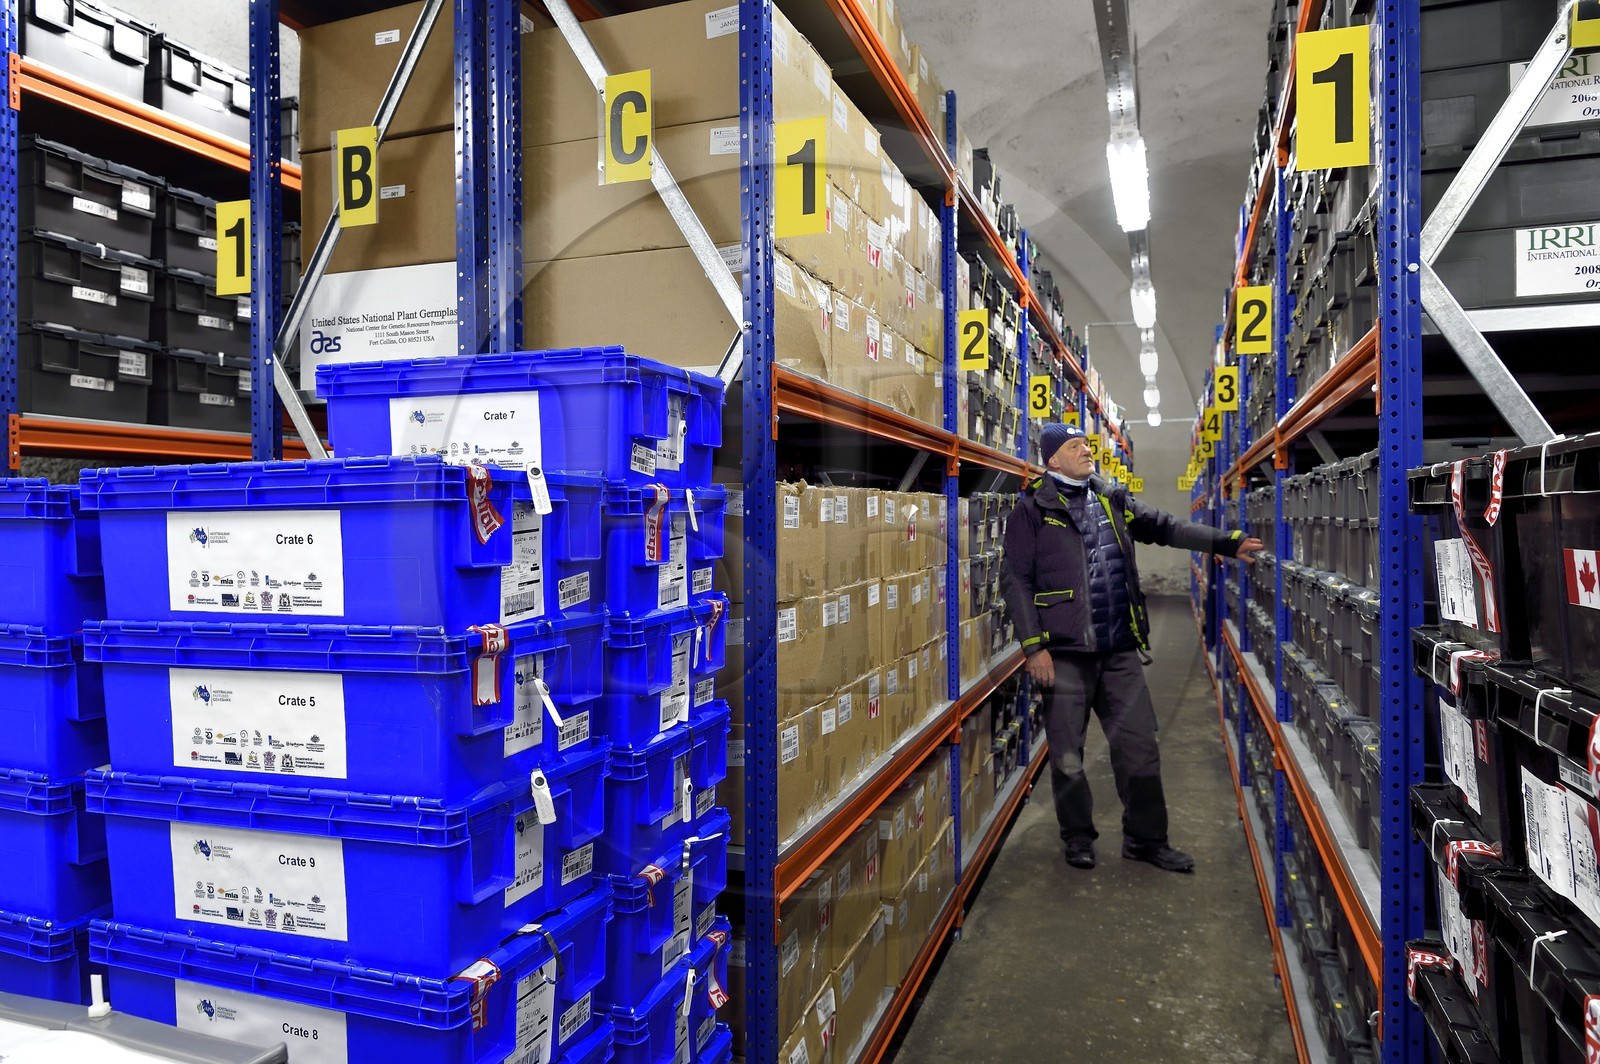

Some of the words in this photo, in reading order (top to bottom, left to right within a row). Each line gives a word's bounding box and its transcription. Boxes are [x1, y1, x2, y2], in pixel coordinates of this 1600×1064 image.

[1312, 53, 1354, 144] 1
[610, 90, 648, 164] C
[342, 145, 373, 210] B
[786, 138, 816, 216] 1
[1527, 225, 1596, 250] IRRI
[225, 218, 246, 278] 1
[312, 318, 336, 328] United
[338, 316, 360, 325] States
[362, 312, 395, 323] National
[397, 310, 418, 320] Plant
[1241, 300, 1268, 342] 2
[963, 321, 984, 360] 2
[1032, 384, 1048, 410] 3
[1218, 374, 1235, 404] 3
[484, 411, 508, 421] Crate
[510, 411, 515, 419] 7
[1207, 414, 1220, 434] 4
[1090, 440, 1098, 455] 5
[1202, 436, 1212, 452] 5
[1102, 452, 1110, 466] 6
[1112, 462, 1118, 473] 7
[1120, 469, 1126, 479] 8
[276, 534, 304, 545] Crate
[307, 534, 313, 545] 6
[278, 694, 306, 706] Crate
[309, 696, 316, 707] 5
[278, 854, 306, 867] Crate
[309, 857, 316, 868] 9
[282, 1023, 309, 1038] Crate
[312, 1030, 318, 1040] 8
